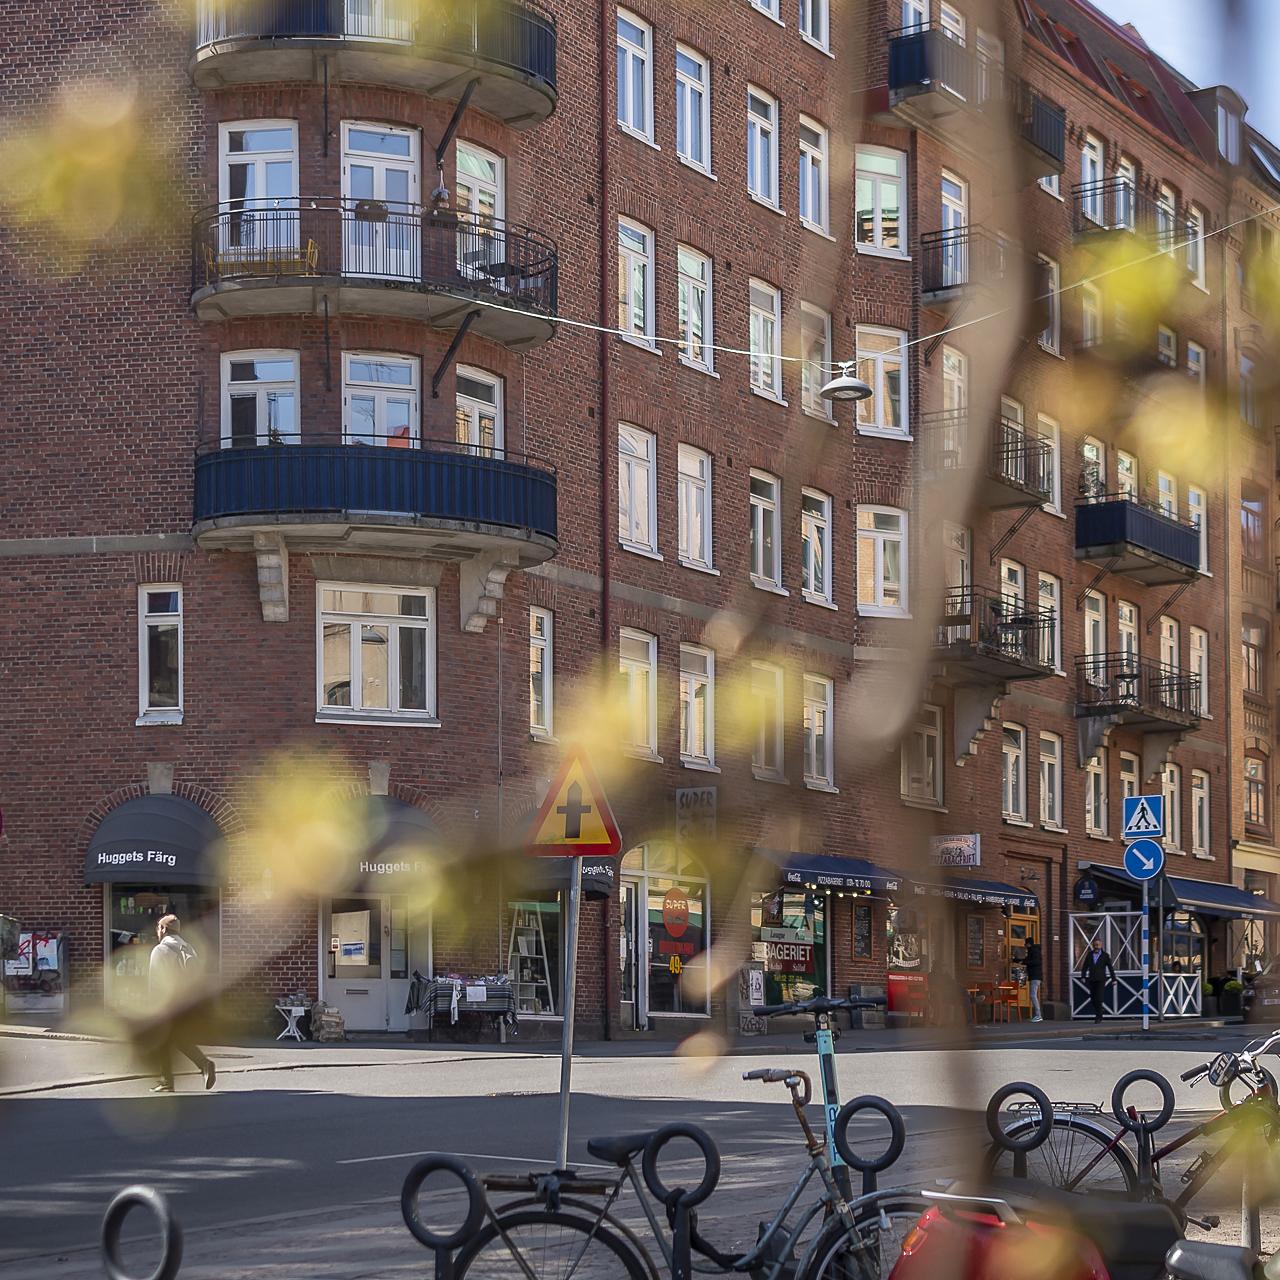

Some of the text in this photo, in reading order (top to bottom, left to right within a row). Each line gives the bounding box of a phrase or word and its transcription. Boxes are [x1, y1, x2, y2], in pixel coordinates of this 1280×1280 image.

[679, 790, 714, 810] SUPER
[98, 850, 176, 867] Huggets Färg
[360, 861, 410, 874] Huggets
[665, 900, 686, 910] SUPER
